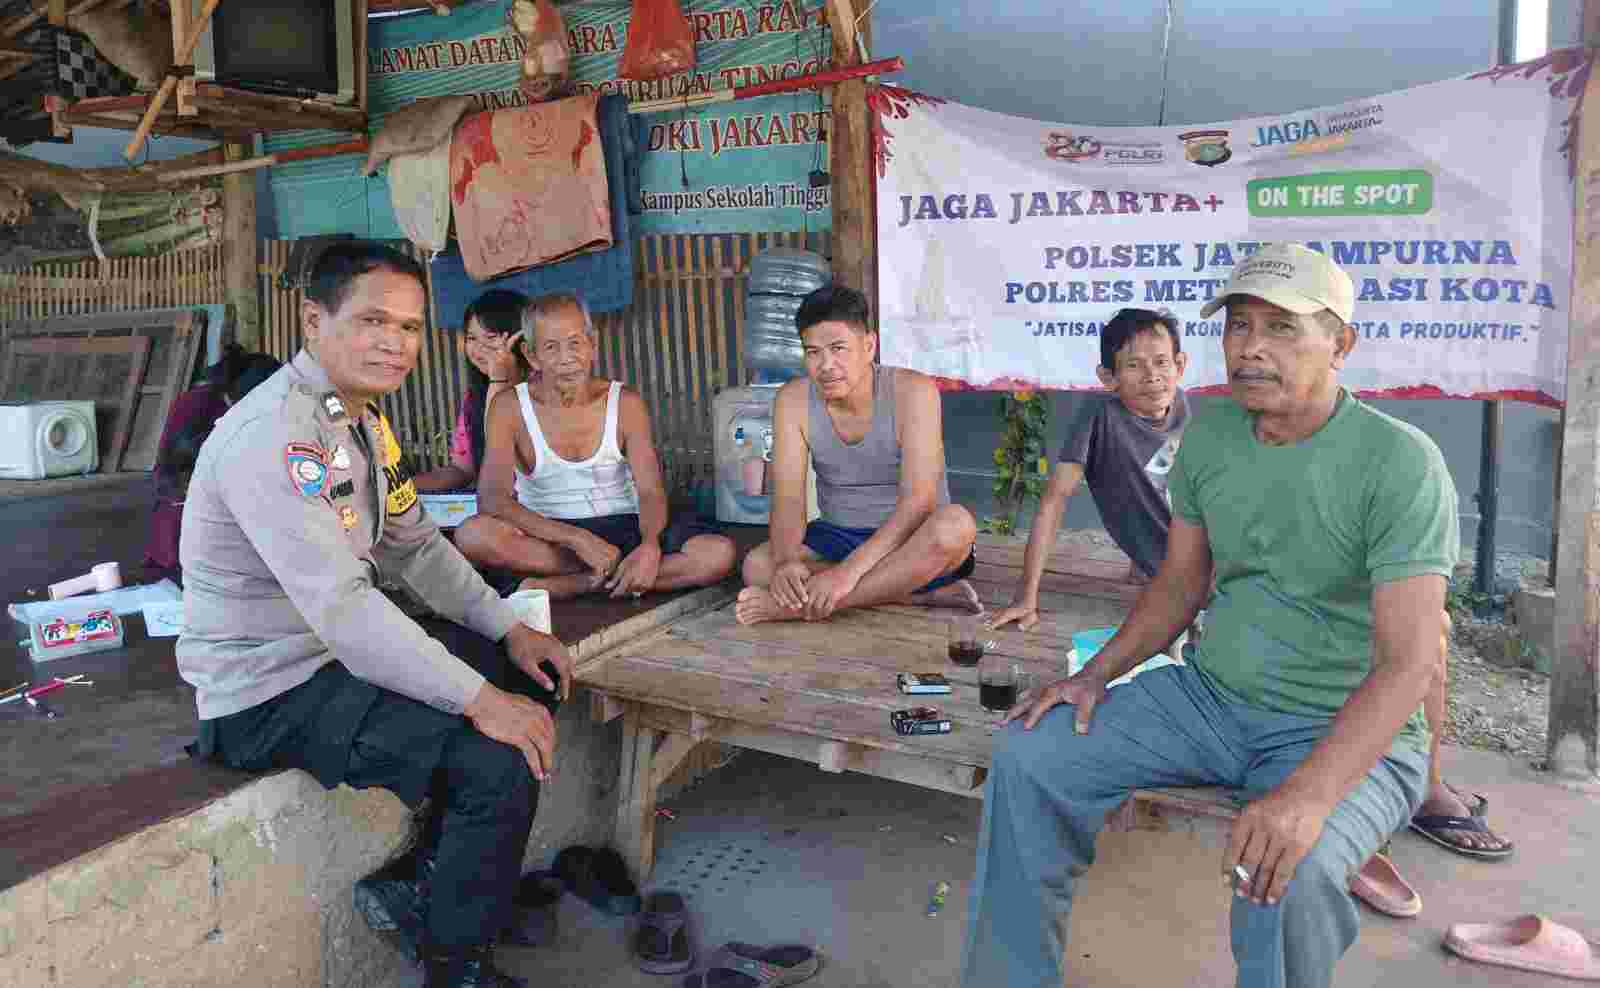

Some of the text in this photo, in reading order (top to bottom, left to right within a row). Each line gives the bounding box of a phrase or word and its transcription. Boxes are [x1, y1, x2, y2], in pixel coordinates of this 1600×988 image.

[448, 34, 528, 67] DATAN
[567, 23, 617, 55] ARA
[649, 112, 832, 156] DKI JAKART
[706, 183, 774, 210] Sekolah
[897, 192, 999, 227] JAGA
[1257, 182, 1419, 208] ON THE SPOT
[1044, 243, 1183, 270] POLSEK
[1005, 277, 1556, 311] POLRES MET ASI KOTA
[1024, 320, 1104, 338] "JATISA
[1184, 321, 1223, 337] KON
